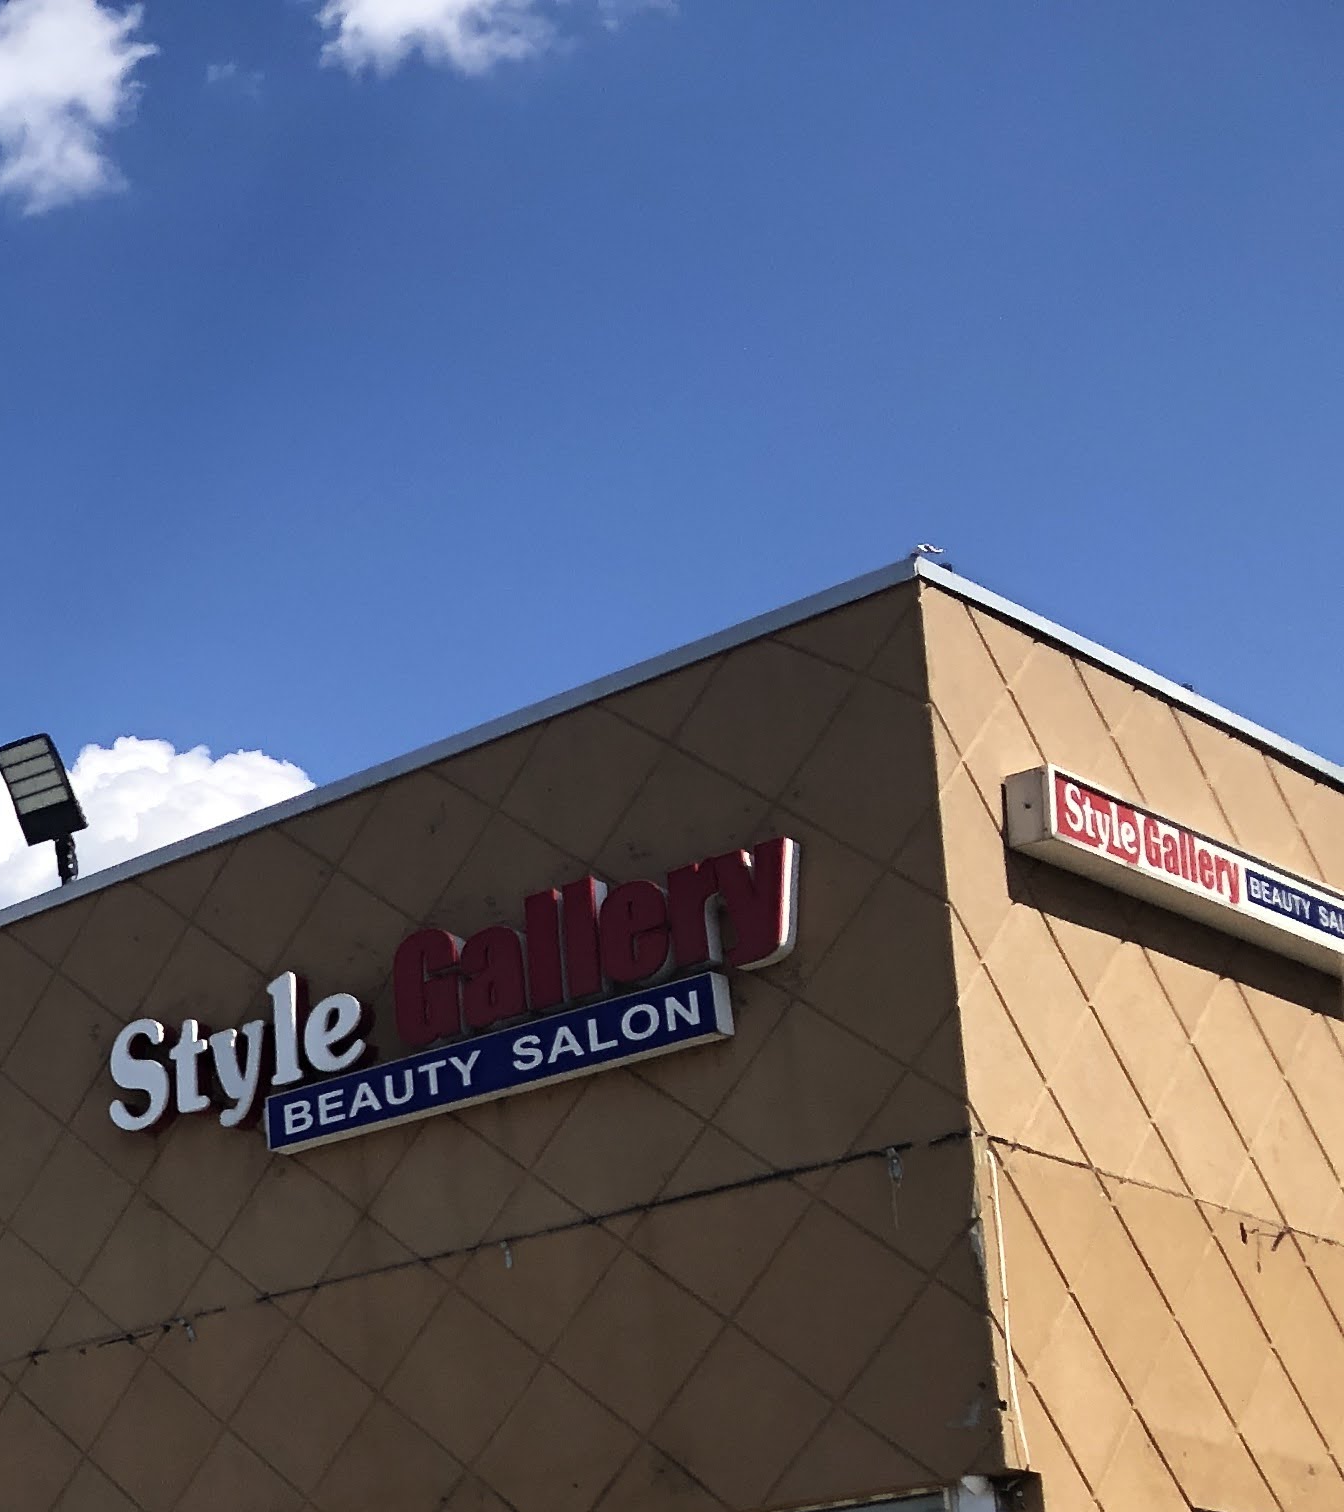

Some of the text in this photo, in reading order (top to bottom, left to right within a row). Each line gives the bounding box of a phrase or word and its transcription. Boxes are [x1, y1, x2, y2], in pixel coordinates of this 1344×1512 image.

[1066, 782, 1240, 905] Style Gallery
[1251, 876, 1311, 920] BEAUTY
[109, 836, 800, 1132] Style Gallery
[283, 988, 701, 1135] BEAUTY SALON
